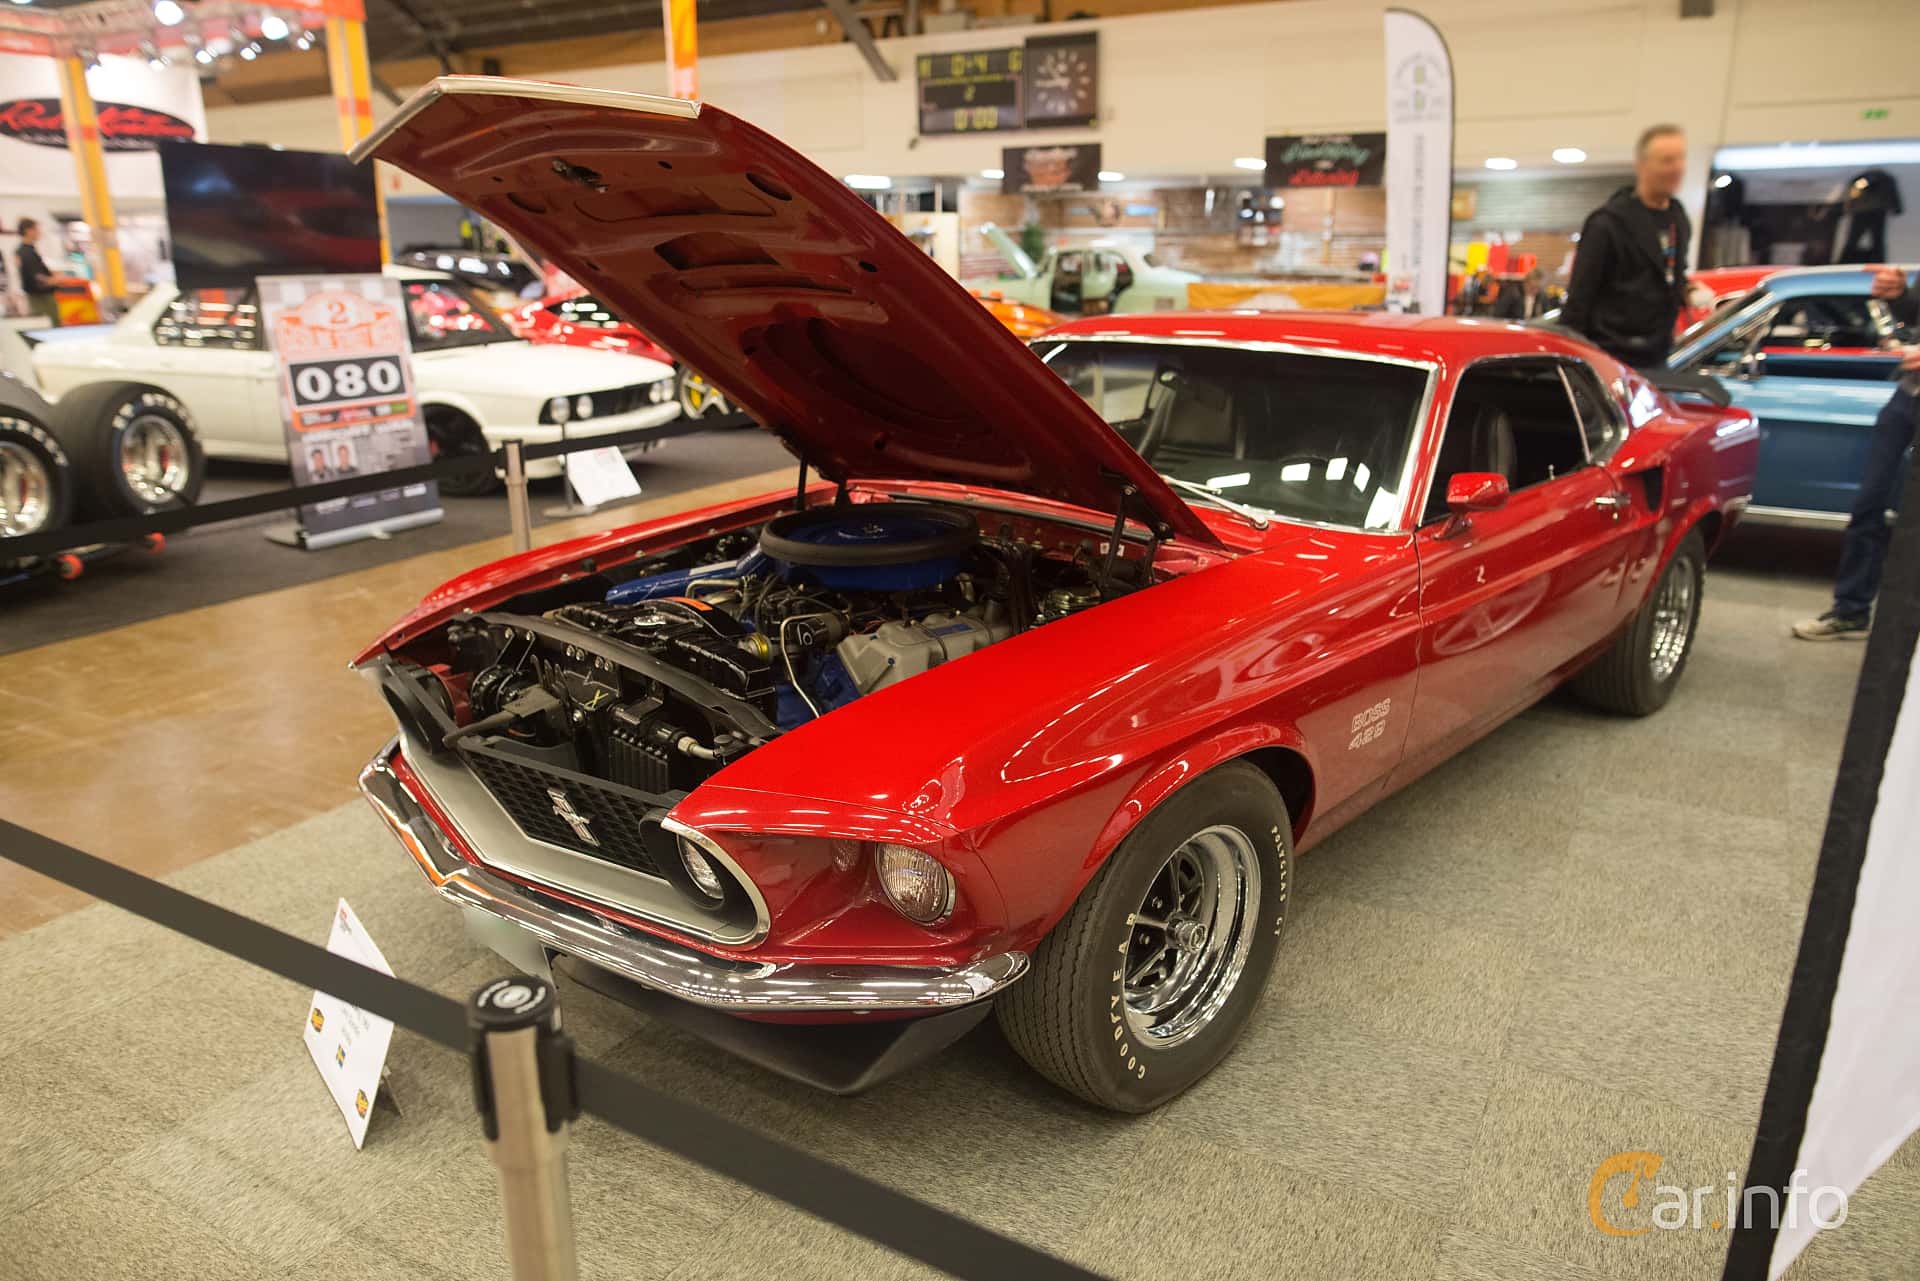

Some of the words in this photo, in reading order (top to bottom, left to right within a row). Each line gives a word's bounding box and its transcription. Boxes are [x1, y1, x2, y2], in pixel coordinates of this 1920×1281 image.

[327, 302, 349, 324] 2
[296, 360, 400, 401] 080
[1351, 698, 1391, 733] BOSS
[1110, 912, 1146, 1080] GOODYEAR
